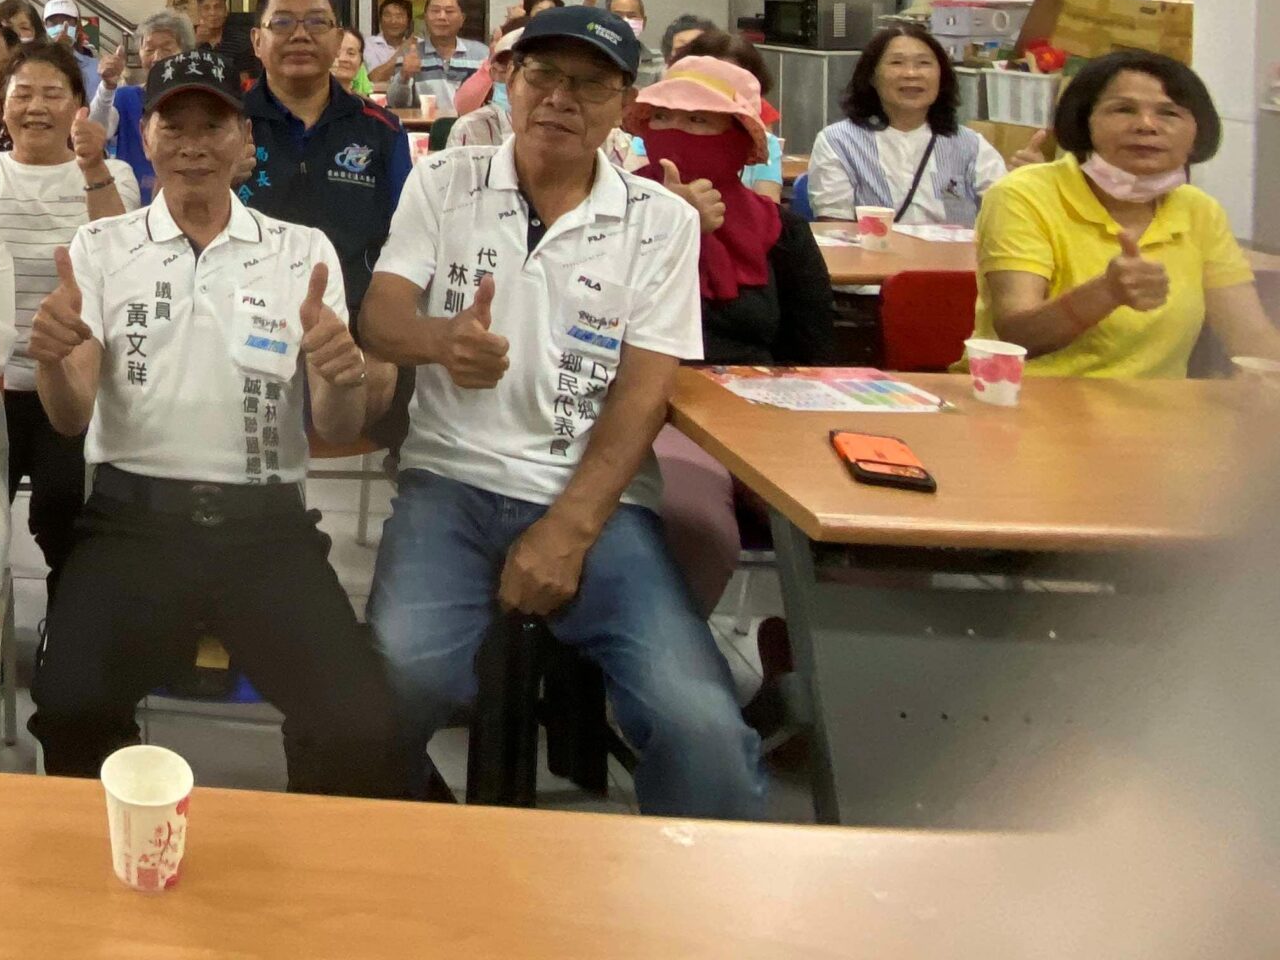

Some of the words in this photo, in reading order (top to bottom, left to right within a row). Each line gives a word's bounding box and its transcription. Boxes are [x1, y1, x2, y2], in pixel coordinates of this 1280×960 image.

[498, 209, 517, 220] FILA
[587, 233, 606, 244] FILA
[578, 275, 602, 292] FILA
[155, 280, 172, 321] 議員
[242, 295, 266, 308] FILA
[126, 303, 149, 386] 黃文祥
[549, 351, 584, 457] 鄉民代表會
